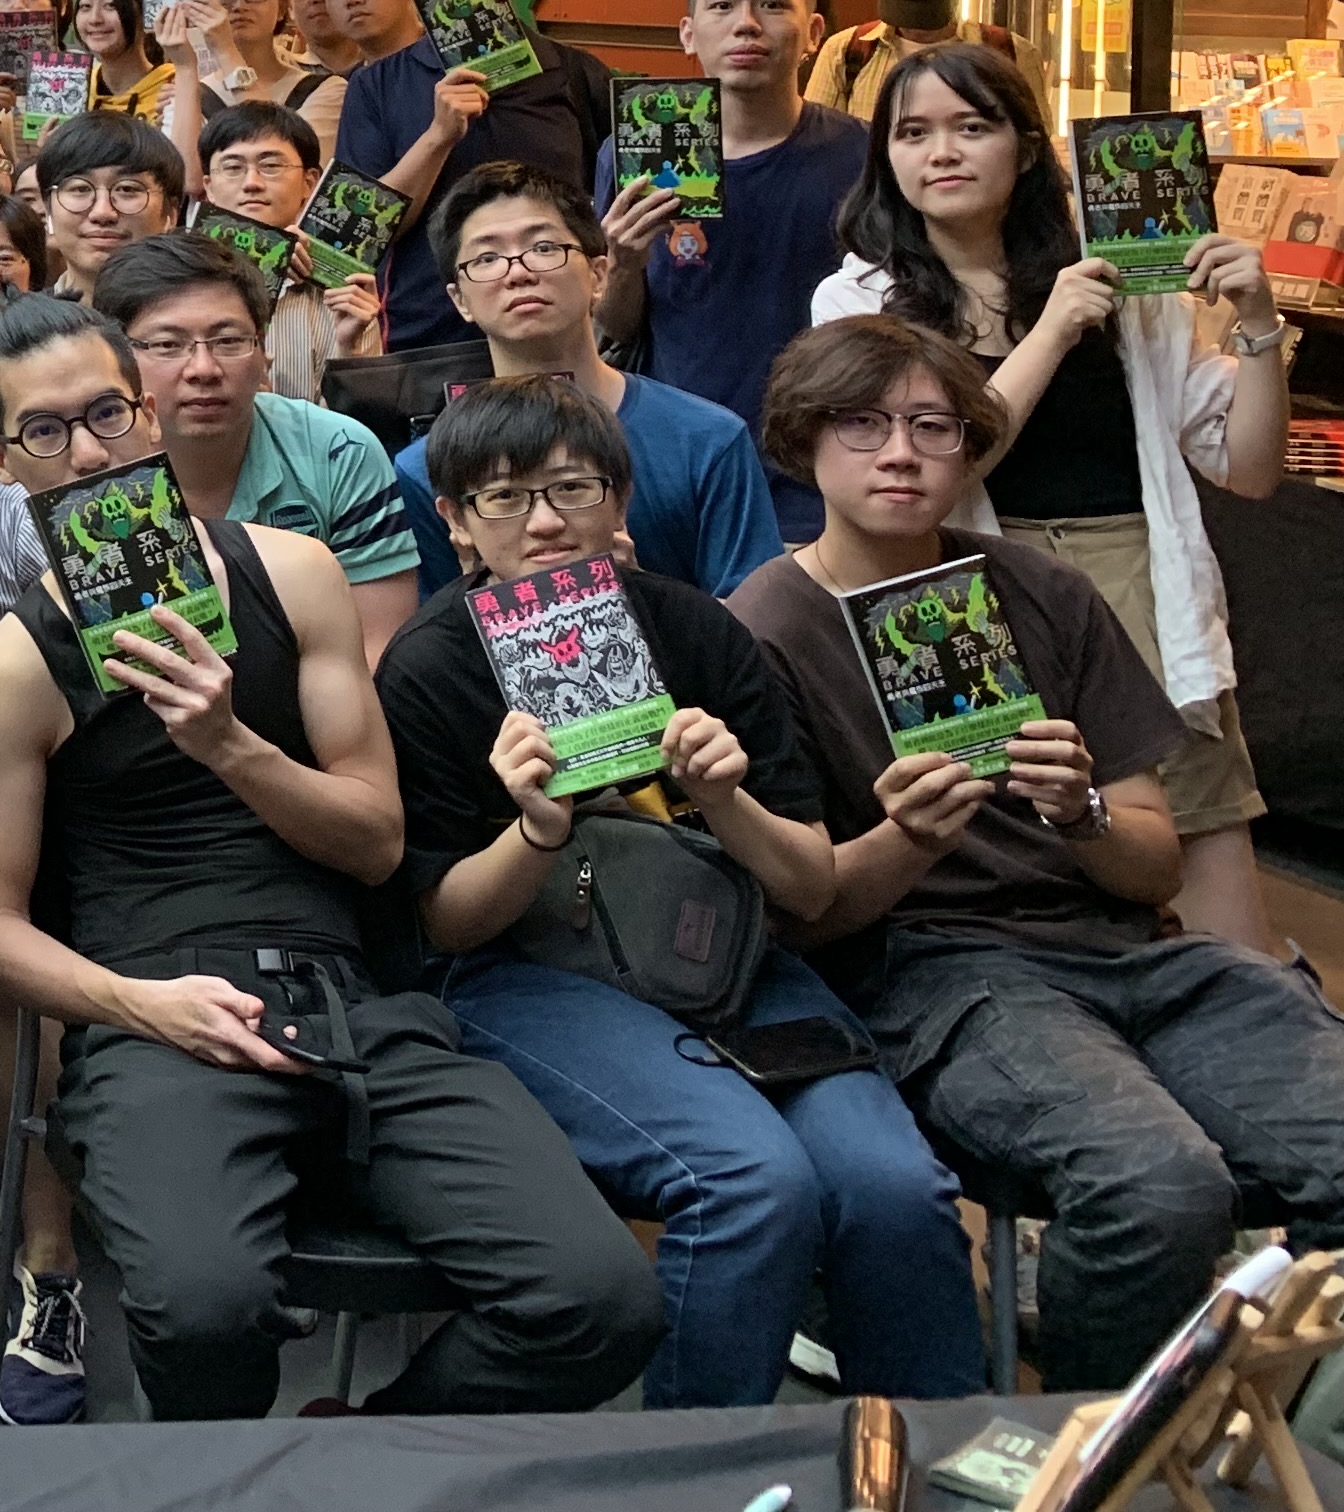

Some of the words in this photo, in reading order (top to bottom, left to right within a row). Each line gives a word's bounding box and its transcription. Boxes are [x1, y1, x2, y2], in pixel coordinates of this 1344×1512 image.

[618, 138, 661, 146] BRAVE
[675, 138, 719, 146] SERIES
[1087, 191, 1141, 203] BRAVE
[1157, 186, 1209, 198] SERIES
[68, 563, 130, 590] BRAVE
[144, 540, 198, 567] SERIES
[473, 560, 616, 614] 勇者系列
[875, 622, 1013, 679] 勇者系列
[882, 666, 944, 691] BRAVE
[959, 644, 1018, 670] SERIES
